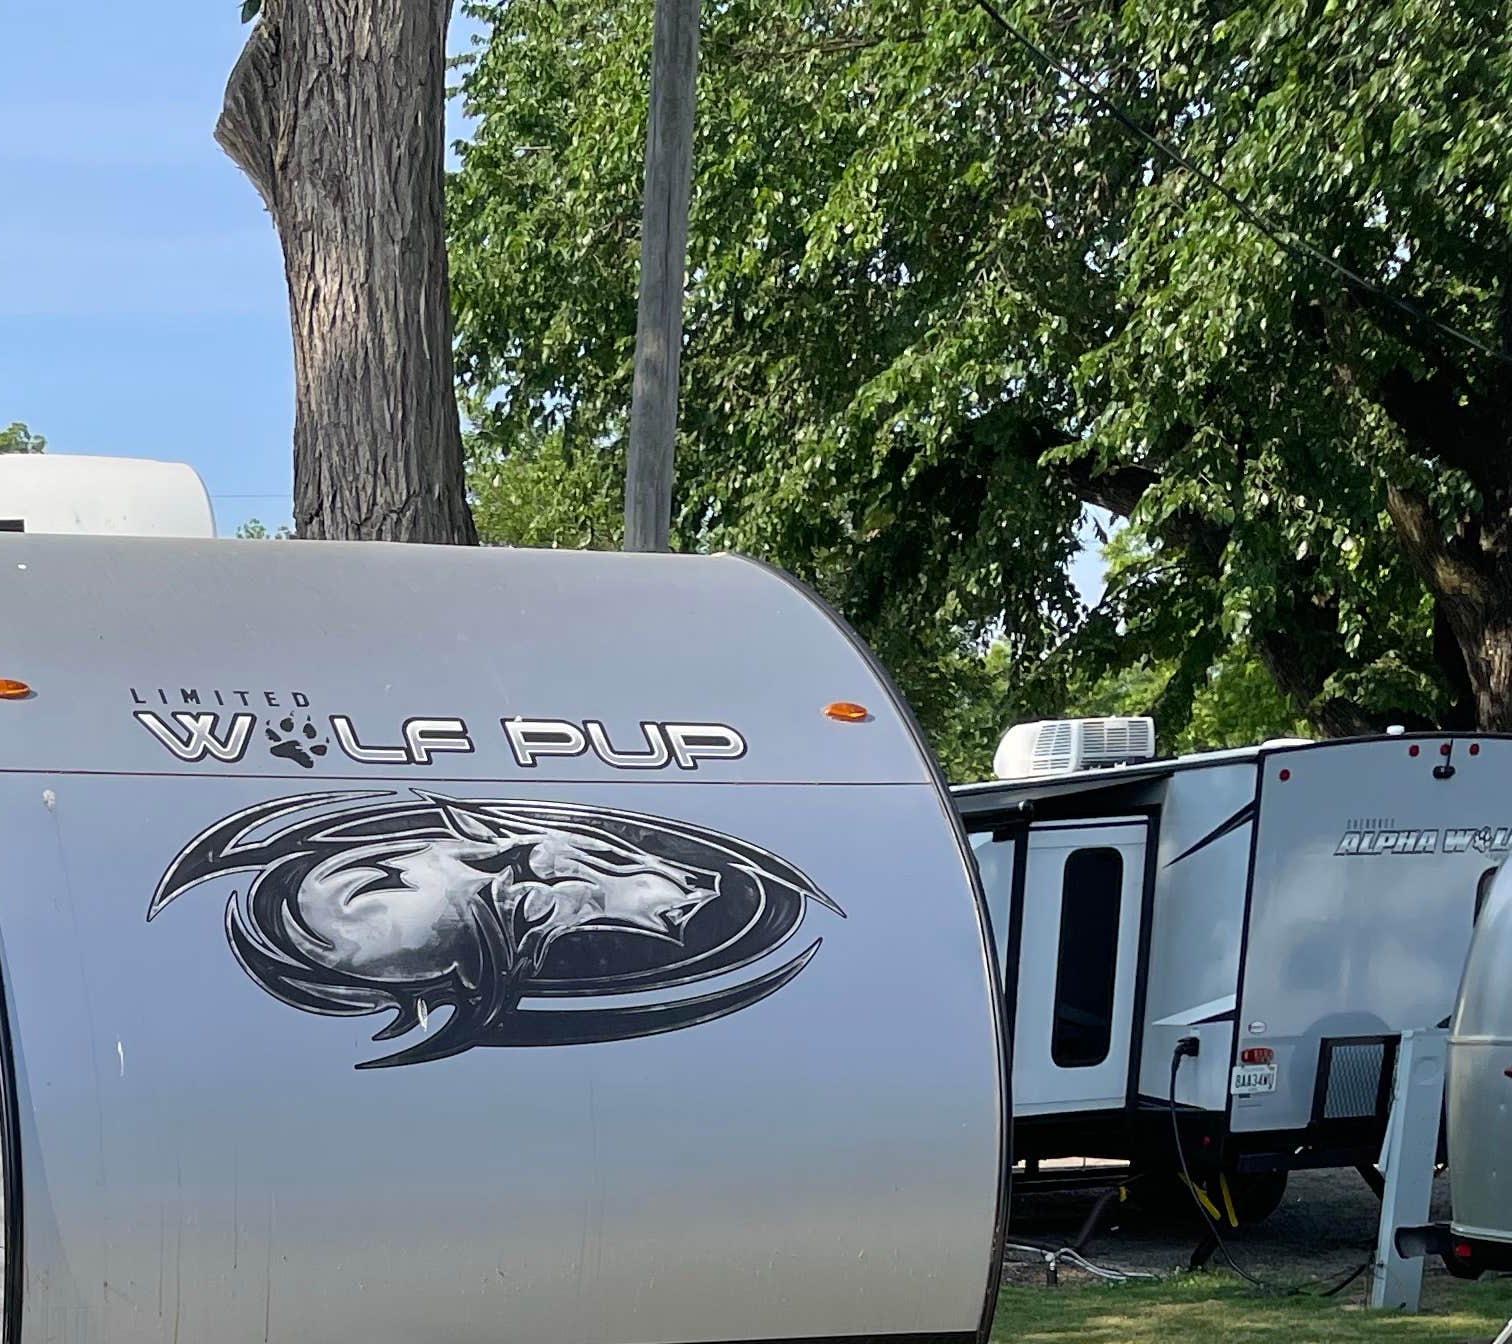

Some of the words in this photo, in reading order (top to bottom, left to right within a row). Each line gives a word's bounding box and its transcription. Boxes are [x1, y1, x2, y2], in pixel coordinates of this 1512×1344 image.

[129, 688, 311, 707] LIMITED
[500, 717, 748, 770] PUP
[1333, 829, 1439, 856] ALPHA
